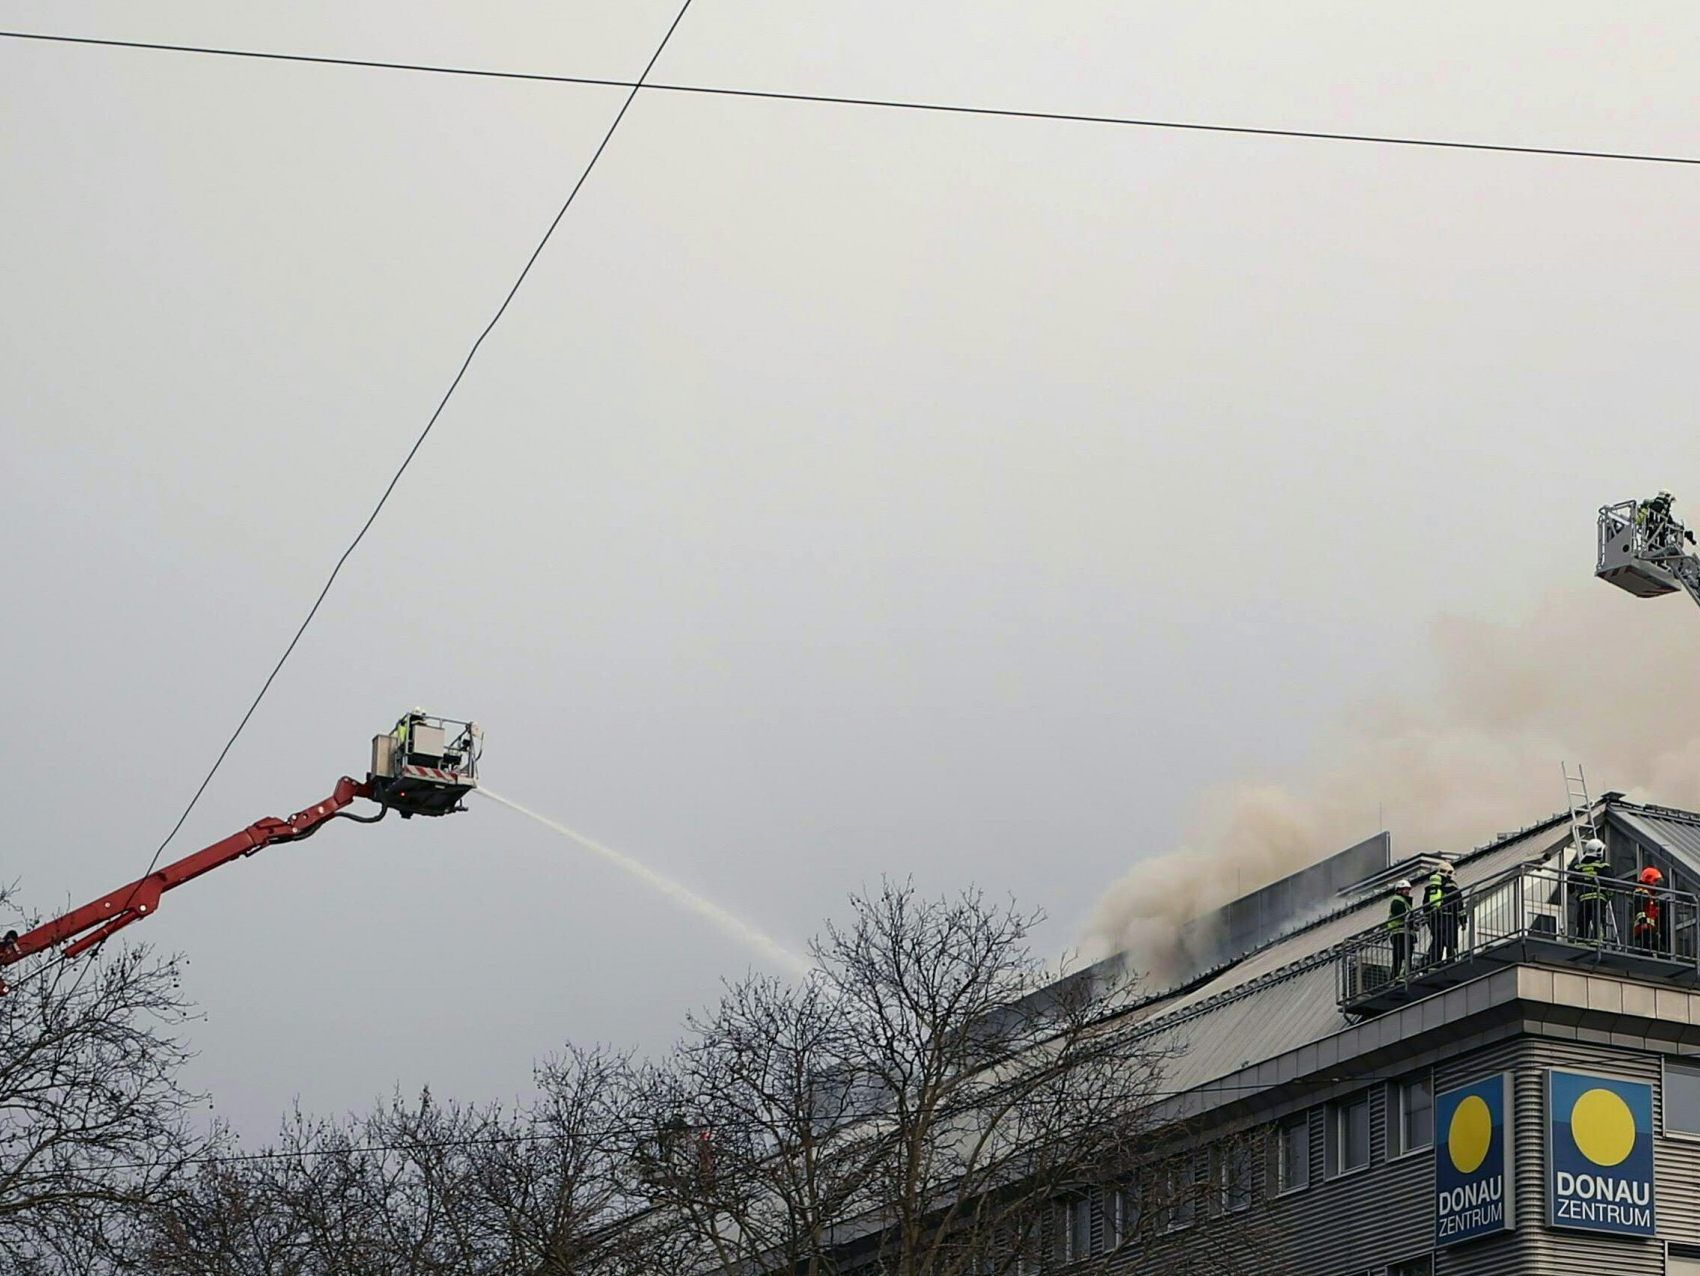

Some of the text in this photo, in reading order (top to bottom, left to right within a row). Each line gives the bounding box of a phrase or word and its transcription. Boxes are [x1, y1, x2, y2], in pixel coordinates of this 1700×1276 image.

[1439, 1174, 1502, 1217] DONAU
[1556, 1171, 1650, 1206] DONAU
[1439, 1202, 1502, 1237] ZENTRUM
[1556, 1198, 1651, 1228] ZENTRUM
